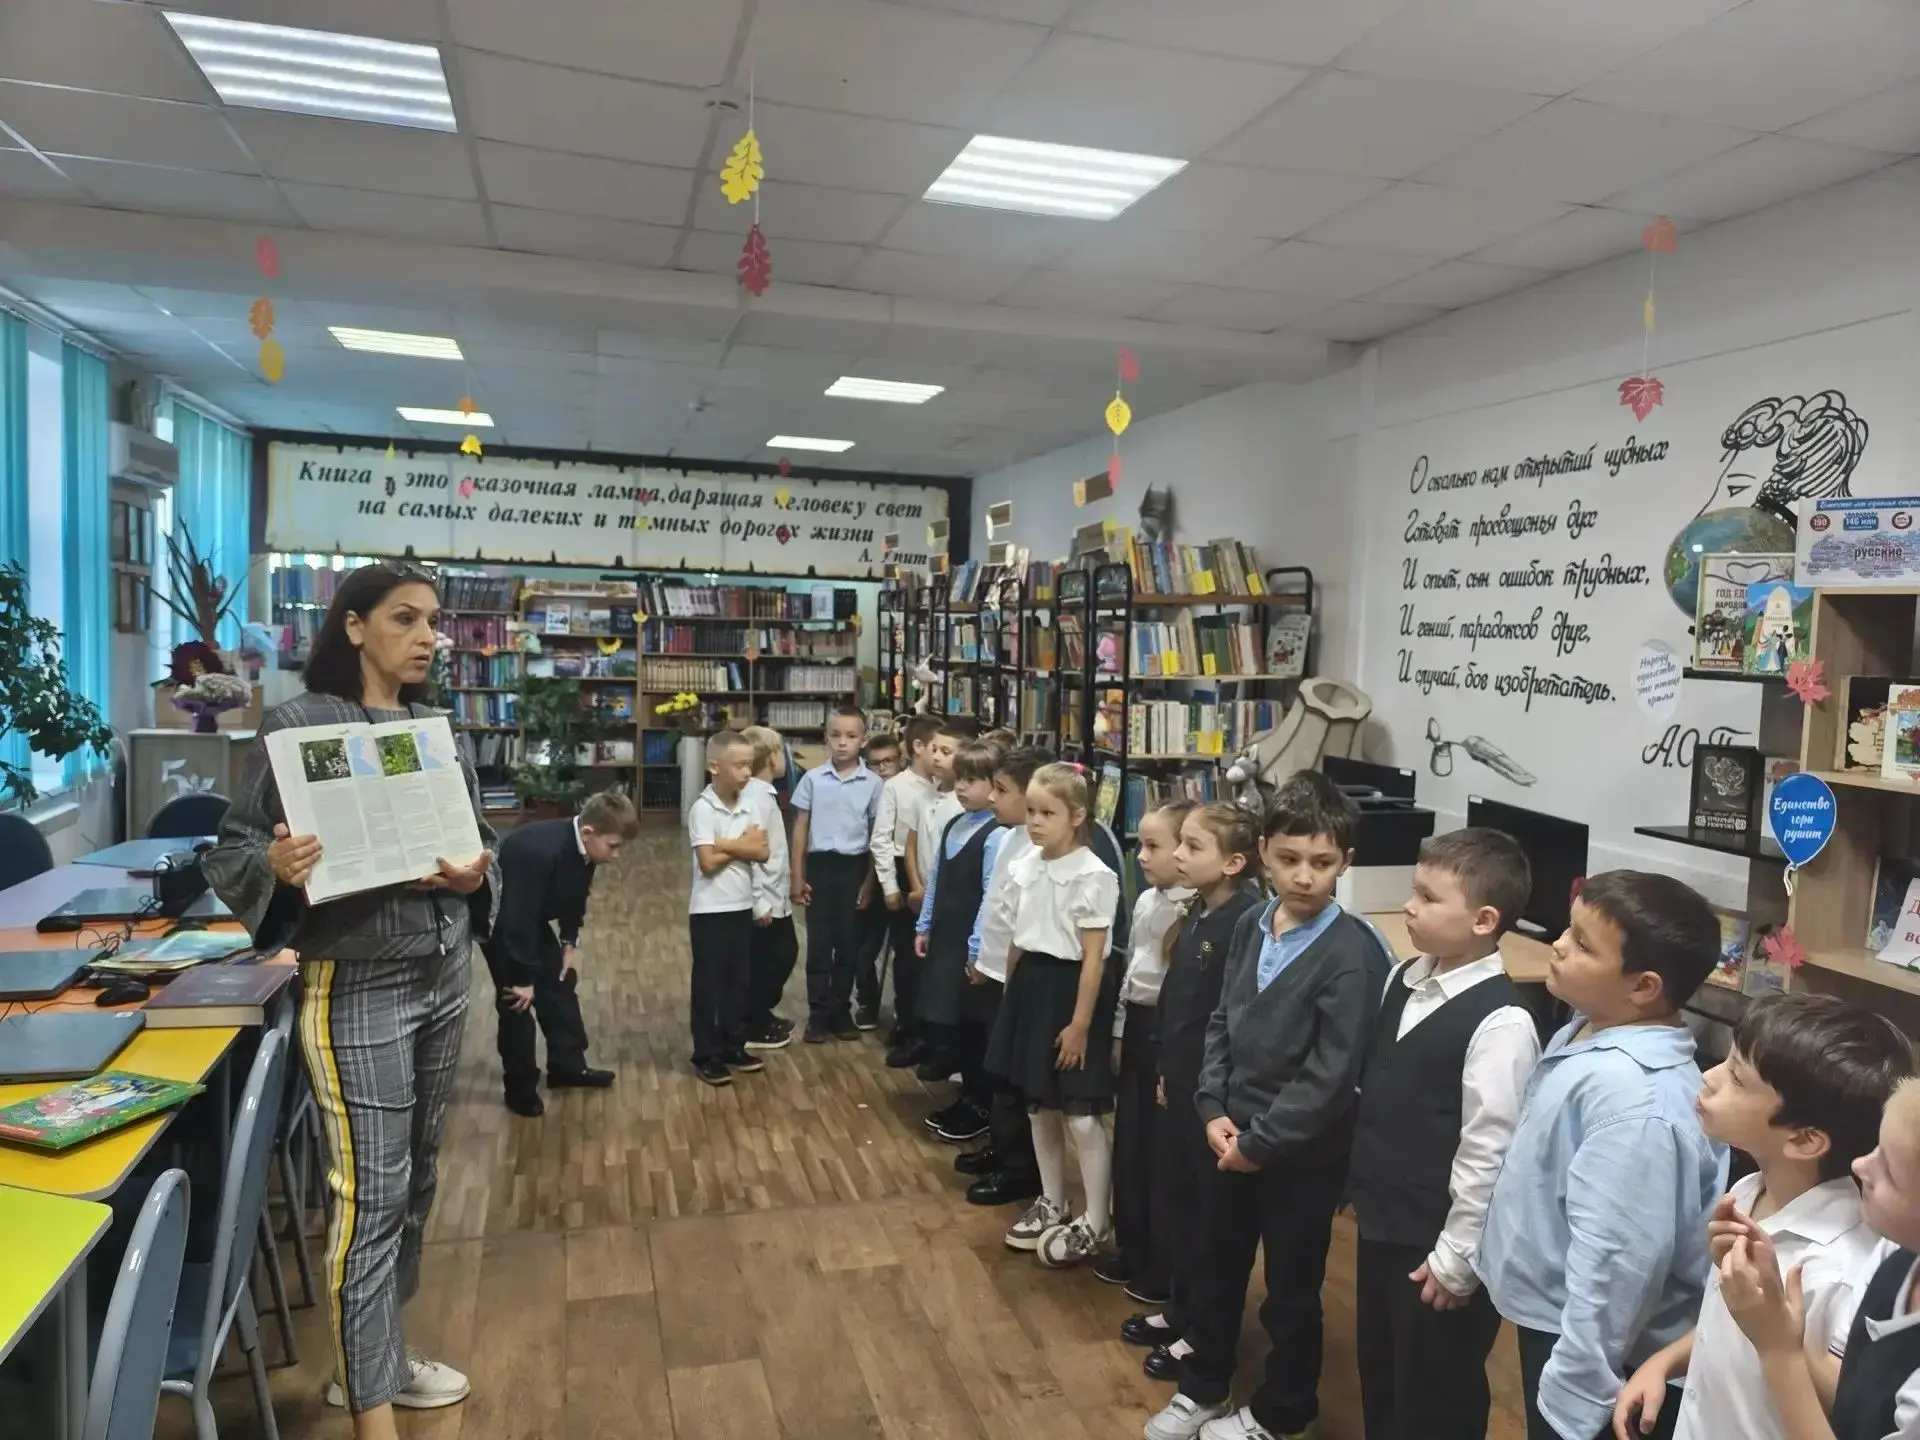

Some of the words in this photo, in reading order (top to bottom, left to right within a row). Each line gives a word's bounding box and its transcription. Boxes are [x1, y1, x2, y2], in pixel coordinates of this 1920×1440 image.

[1410, 454, 1429, 494] О
[1427, 470, 1477, 492] сколько
[1481, 464, 1509, 488] нам
[1514, 441, 1597, 488] открытий
[1603, 434, 1669, 477] чудных
[299, 460, 372, 485] Книга
[405, 471, 449, 489] это
[875, 501, 923, 518] свет
[357, 499, 387, 516] на
[398, 501, 477, 521] самых
[488, 501, 583, 527] далеких
[594, 512, 608, 528] и
[617, 513, 710, 534] тмных
[719, 512, 801, 541] дорогх
[809, 526, 875, 543] жизни
[1404, 508, 1461, 544] Готовят
[1566, 498, 1599, 540] дух
[858, 547, 873, 563] А.
[1402, 557, 1418, 590] И
[1422, 569, 1461, 591] опыт,
[1465, 571, 1490, 588] сын
[1499, 559, 1554, 588] ошибок
[1562, 552, 1650, 600] трудных,
[1854, 547, 1903, 562] русские
[1715, 588, 1732, 600] ГОД
[1399, 603, 1415, 636] И
[1417, 614, 1456, 640] гений,
[1459, 605, 1543, 652] парадоксов
[1551, 610, 1591, 657] друг,
[1397, 648, 1413, 683] И
[1414, 665, 1460, 696] случай,
[1464, 661, 1489, 690] бог
[1494, 665, 1616, 713] изобретатель.
[1773, 795, 1830, 815] Единство
[1783, 829, 1822, 844] рушит
